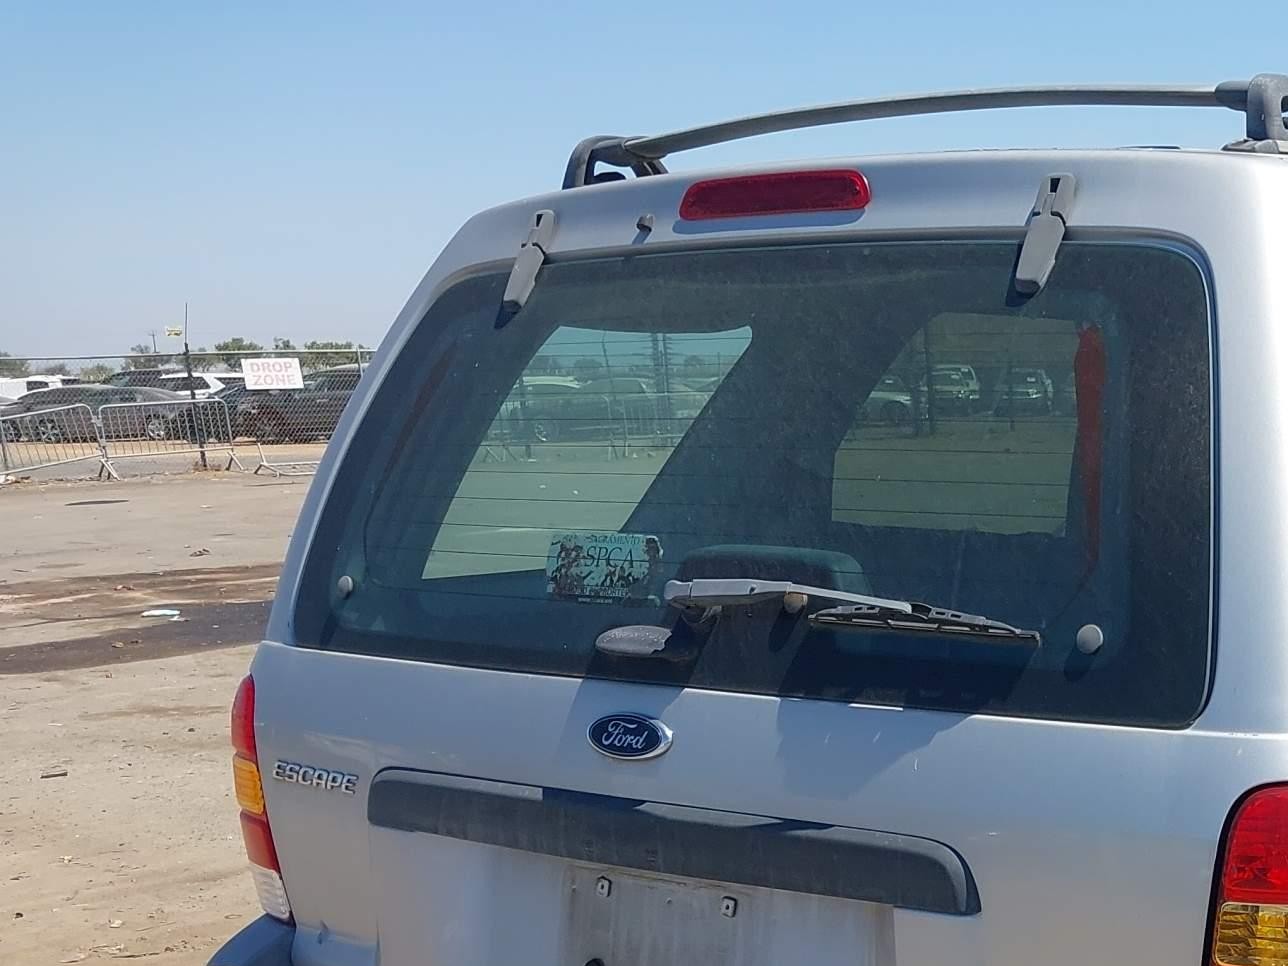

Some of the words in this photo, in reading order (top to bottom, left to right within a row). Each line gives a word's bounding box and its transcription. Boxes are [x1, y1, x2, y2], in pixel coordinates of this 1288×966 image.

[250, 361, 292, 373] DROP
[252, 374, 296, 386] ZONE
[584, 547, 634, 569] SPCA
[602, 720, 648, 749] Ford
[272, 760, 358, 794] ESCAPE
